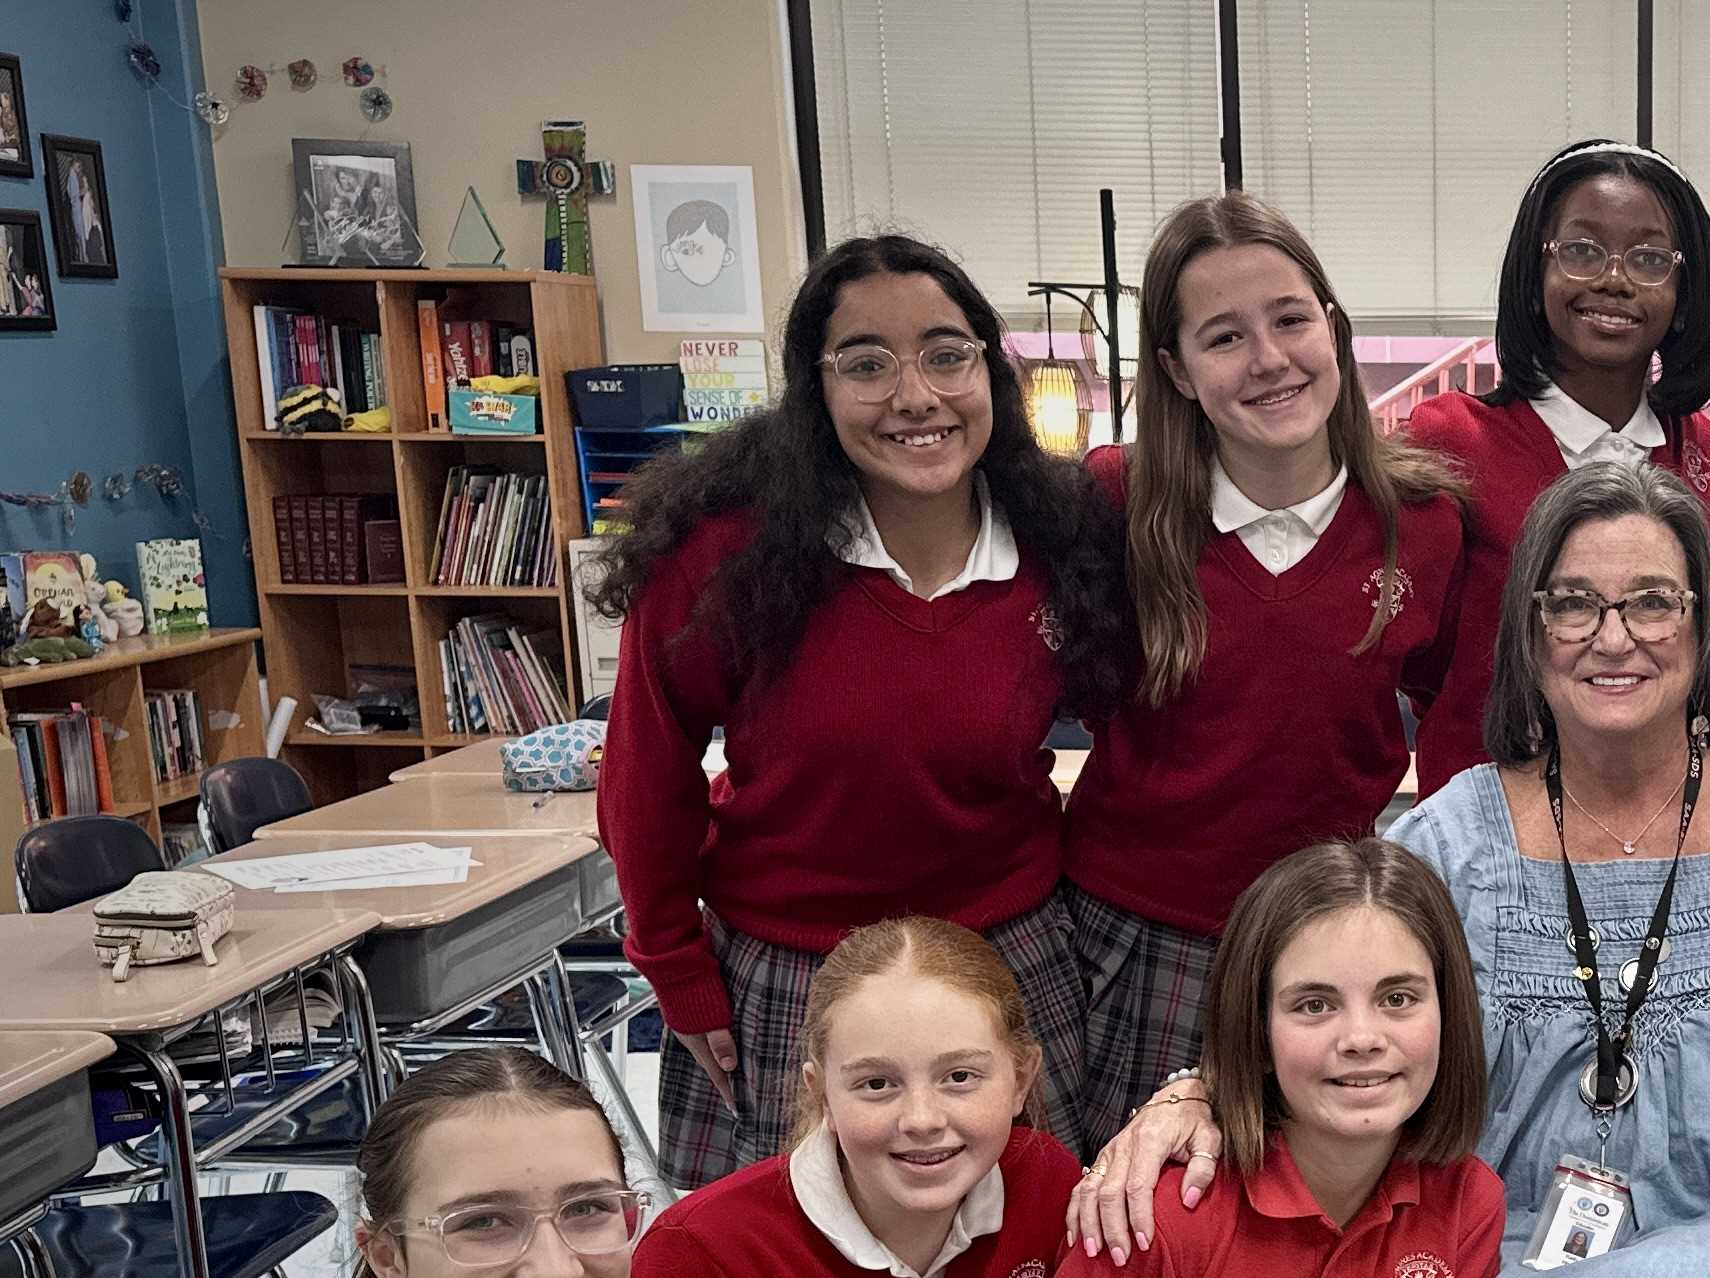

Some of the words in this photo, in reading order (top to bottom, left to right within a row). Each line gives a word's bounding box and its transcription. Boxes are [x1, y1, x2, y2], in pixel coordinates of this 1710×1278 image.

[683, 342, 739, 357] NEVER
[684, 358, 721, 372] LOSE
[688, 373, 736, 388] YOUR
[688, 391, 722, 406] SENSE
[728, 390, 744, 405] OF
[690, 407, 753, 421] WONDE
